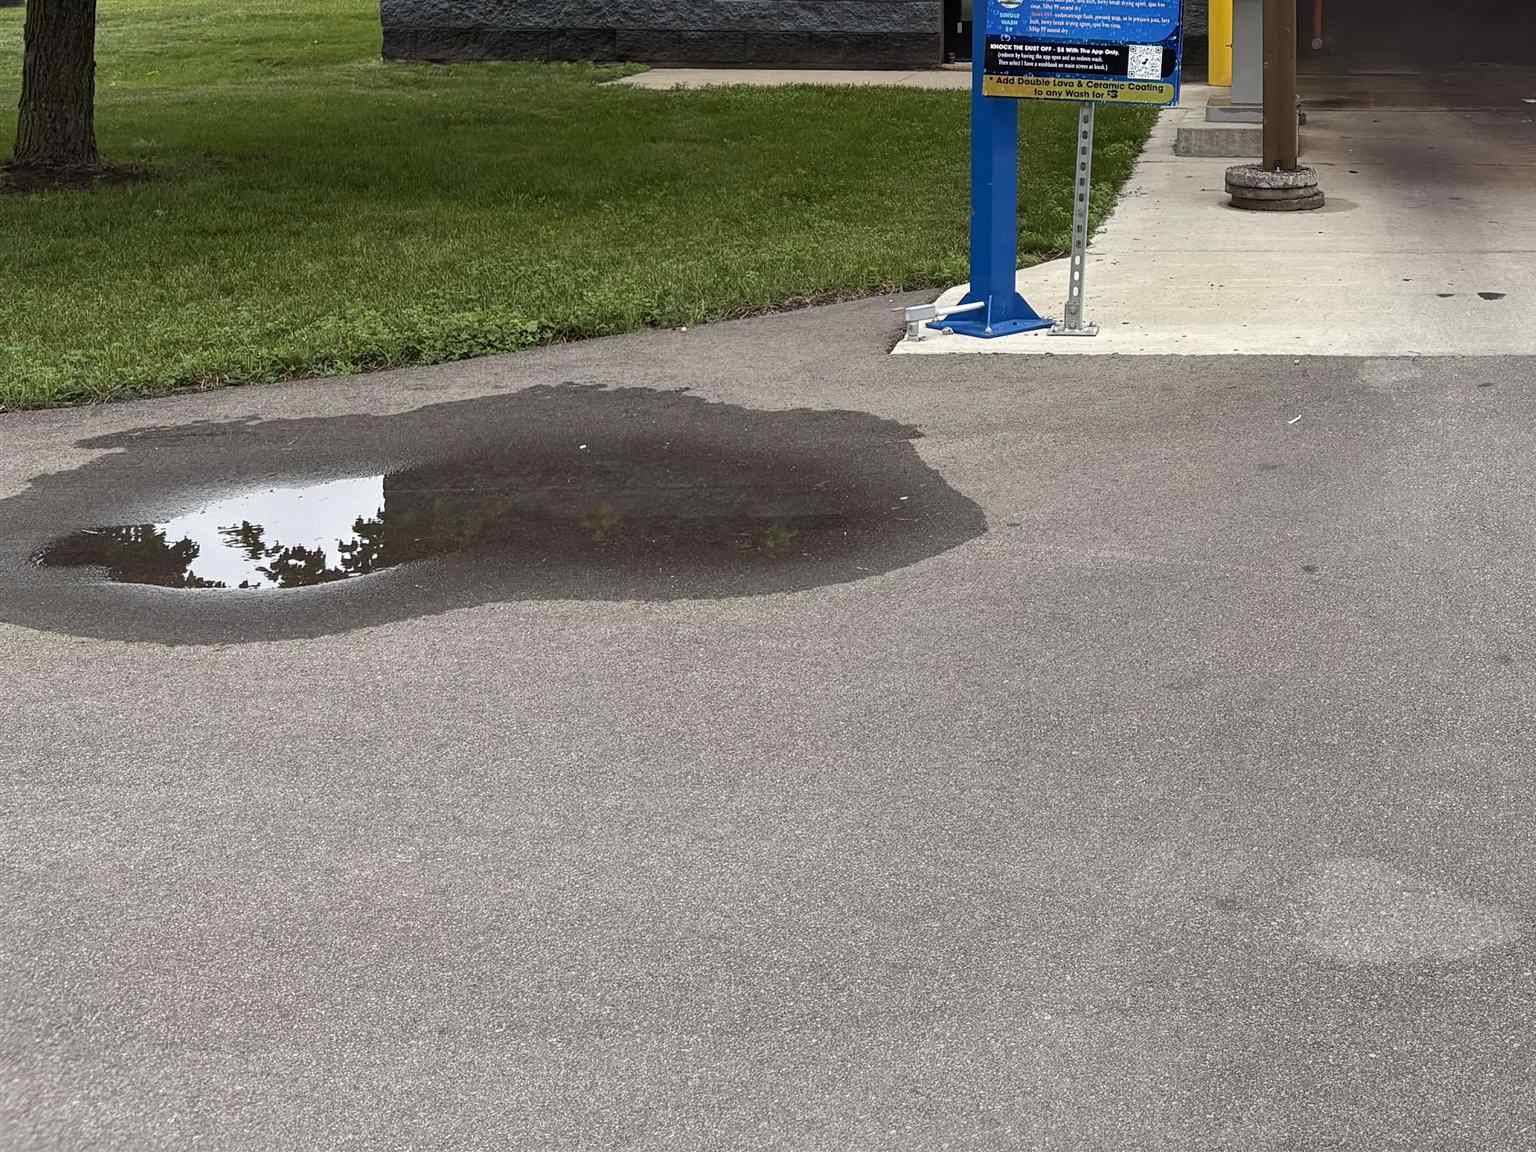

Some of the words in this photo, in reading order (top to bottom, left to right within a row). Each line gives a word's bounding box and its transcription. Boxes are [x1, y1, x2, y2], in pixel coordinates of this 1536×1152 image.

[996, 76, 1015, 86] Add
[1017, 77, 1050, 88] Double
[1053, 79, 1074, 89] Lava
[1077, 80, 1084, 88] &
[1087, 80, 1125, 90] Ceramic
[1128, 82, 1164, 94] Coating
[1045, 90, 1063, 99] any
[1065, 89, 1090, 98] Wash
